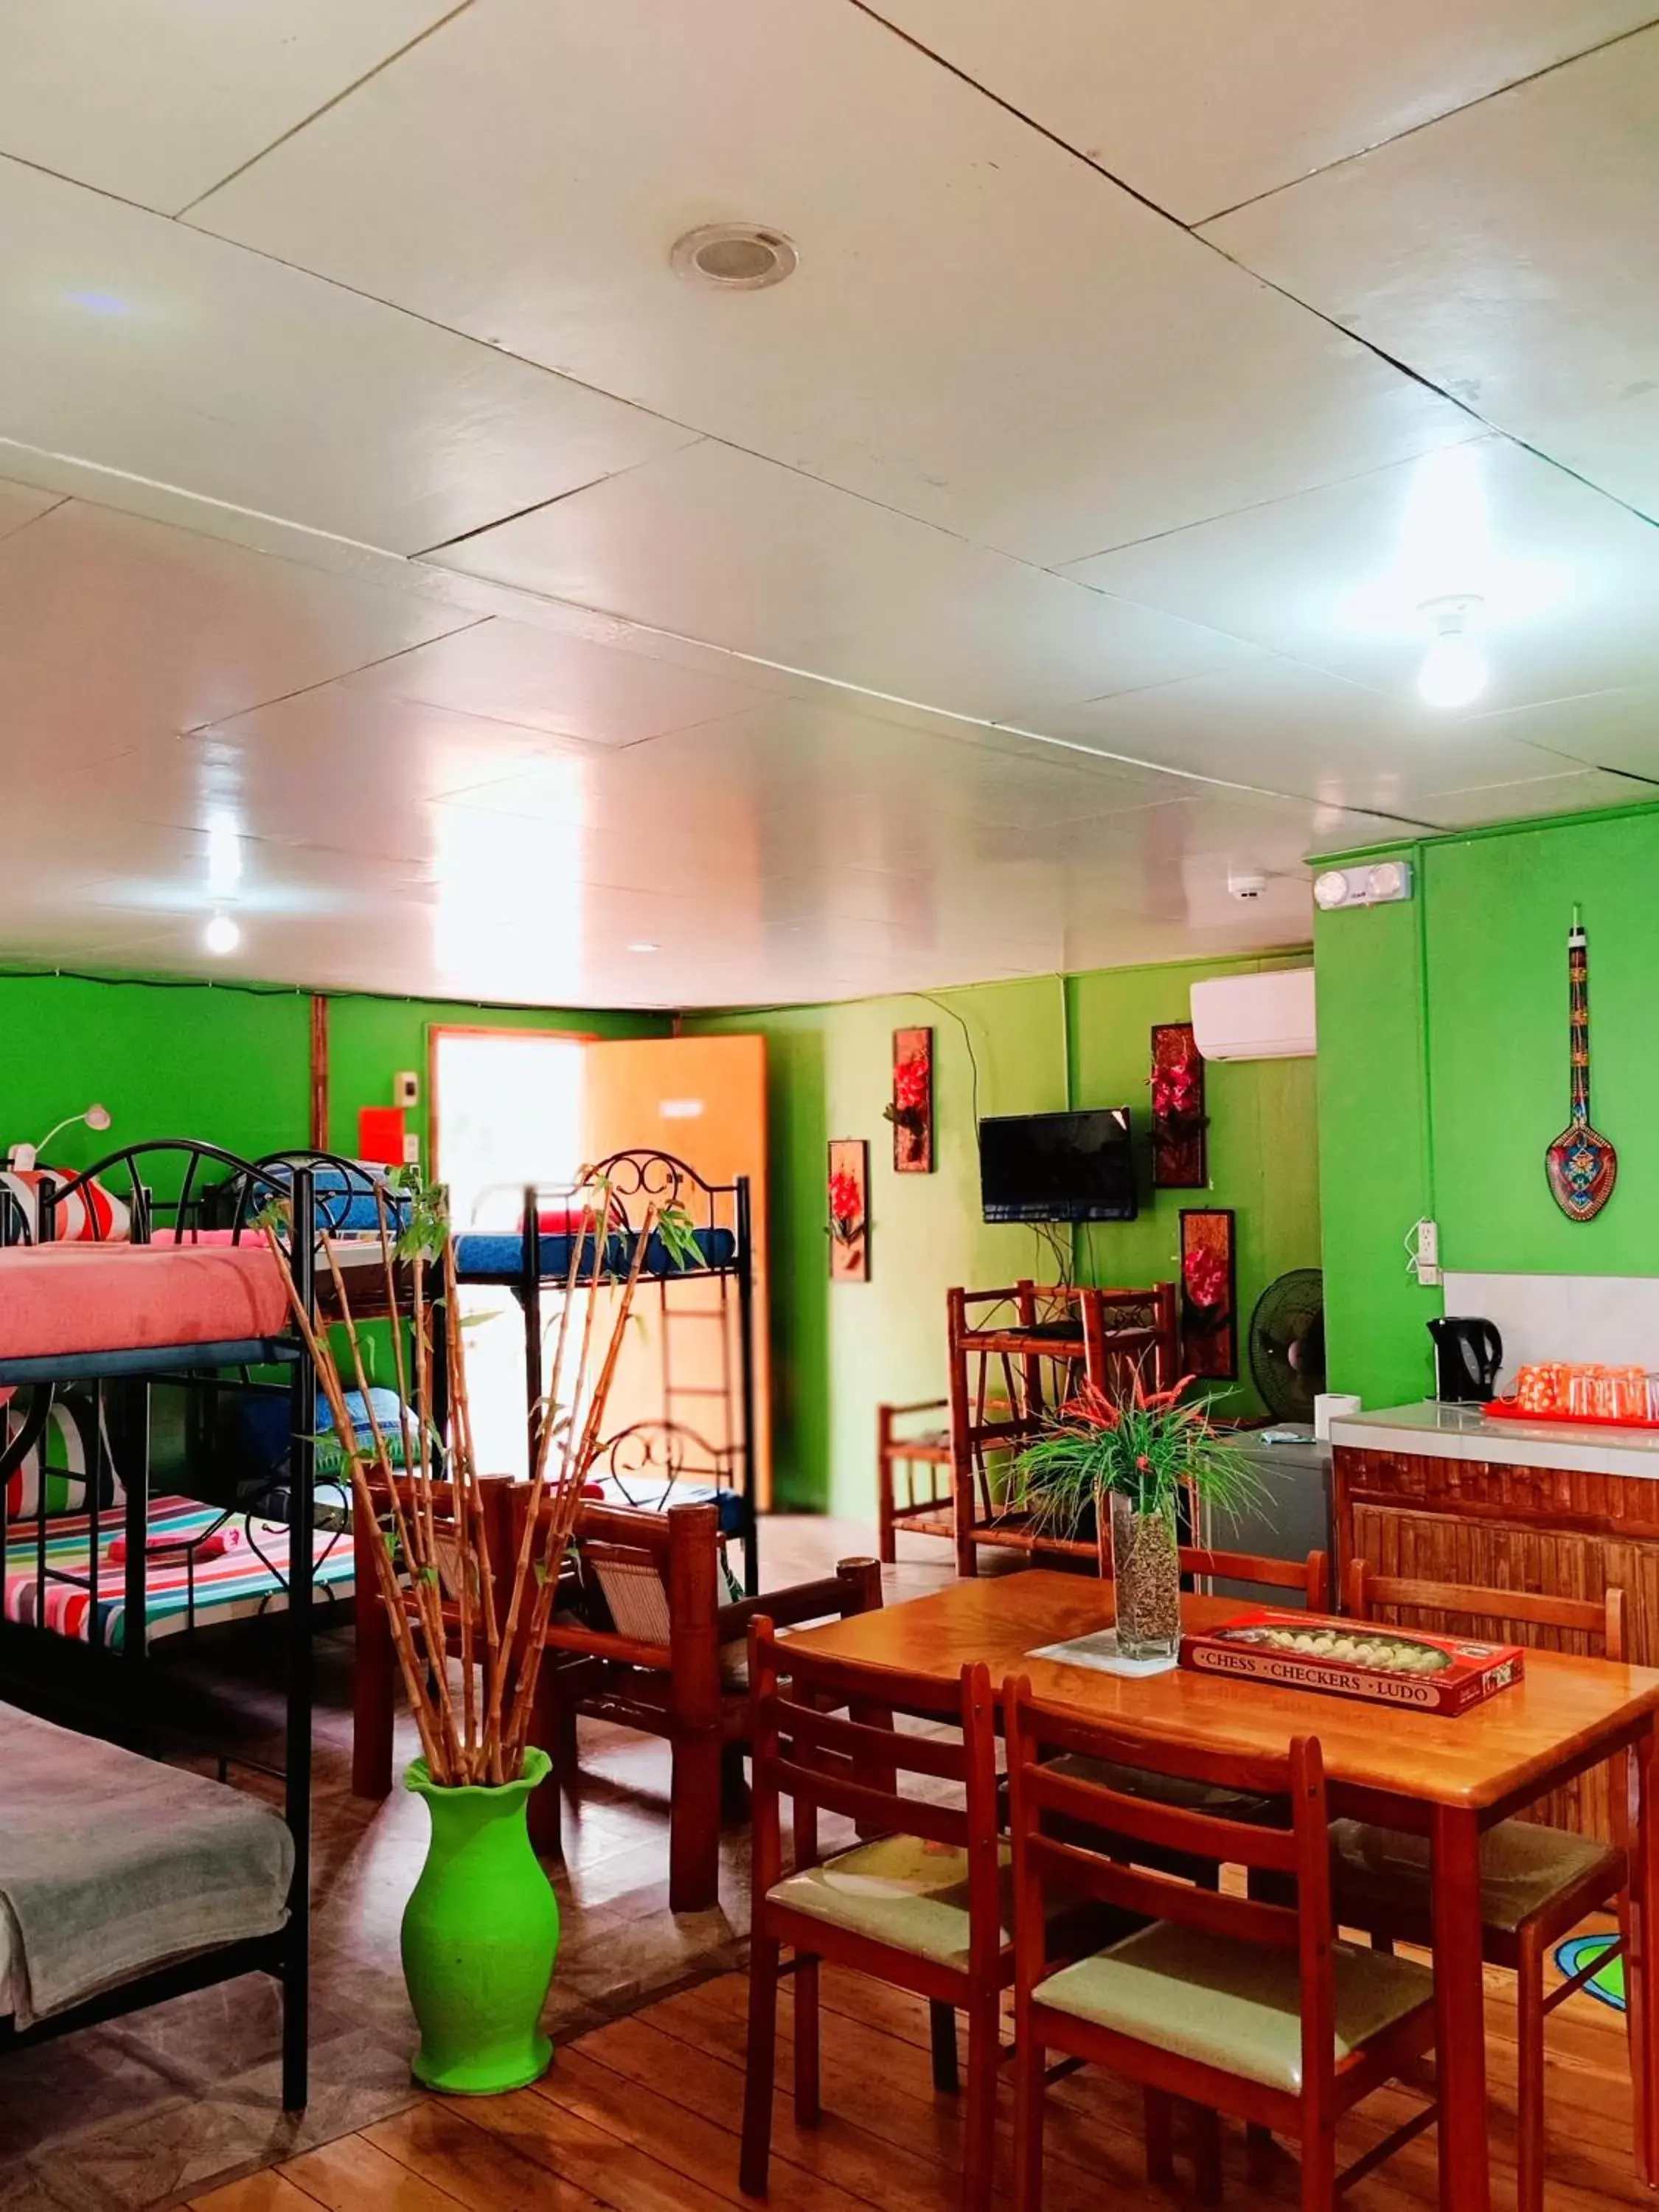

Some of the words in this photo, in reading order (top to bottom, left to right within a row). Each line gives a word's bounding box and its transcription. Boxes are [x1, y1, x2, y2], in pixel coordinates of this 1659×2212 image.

[1206, 1652, 1256, 1672] CHESS
[1270, 1663, 1360, 1690] CHECKERS
[1377, 1681, 1428, 1702] LUDO
